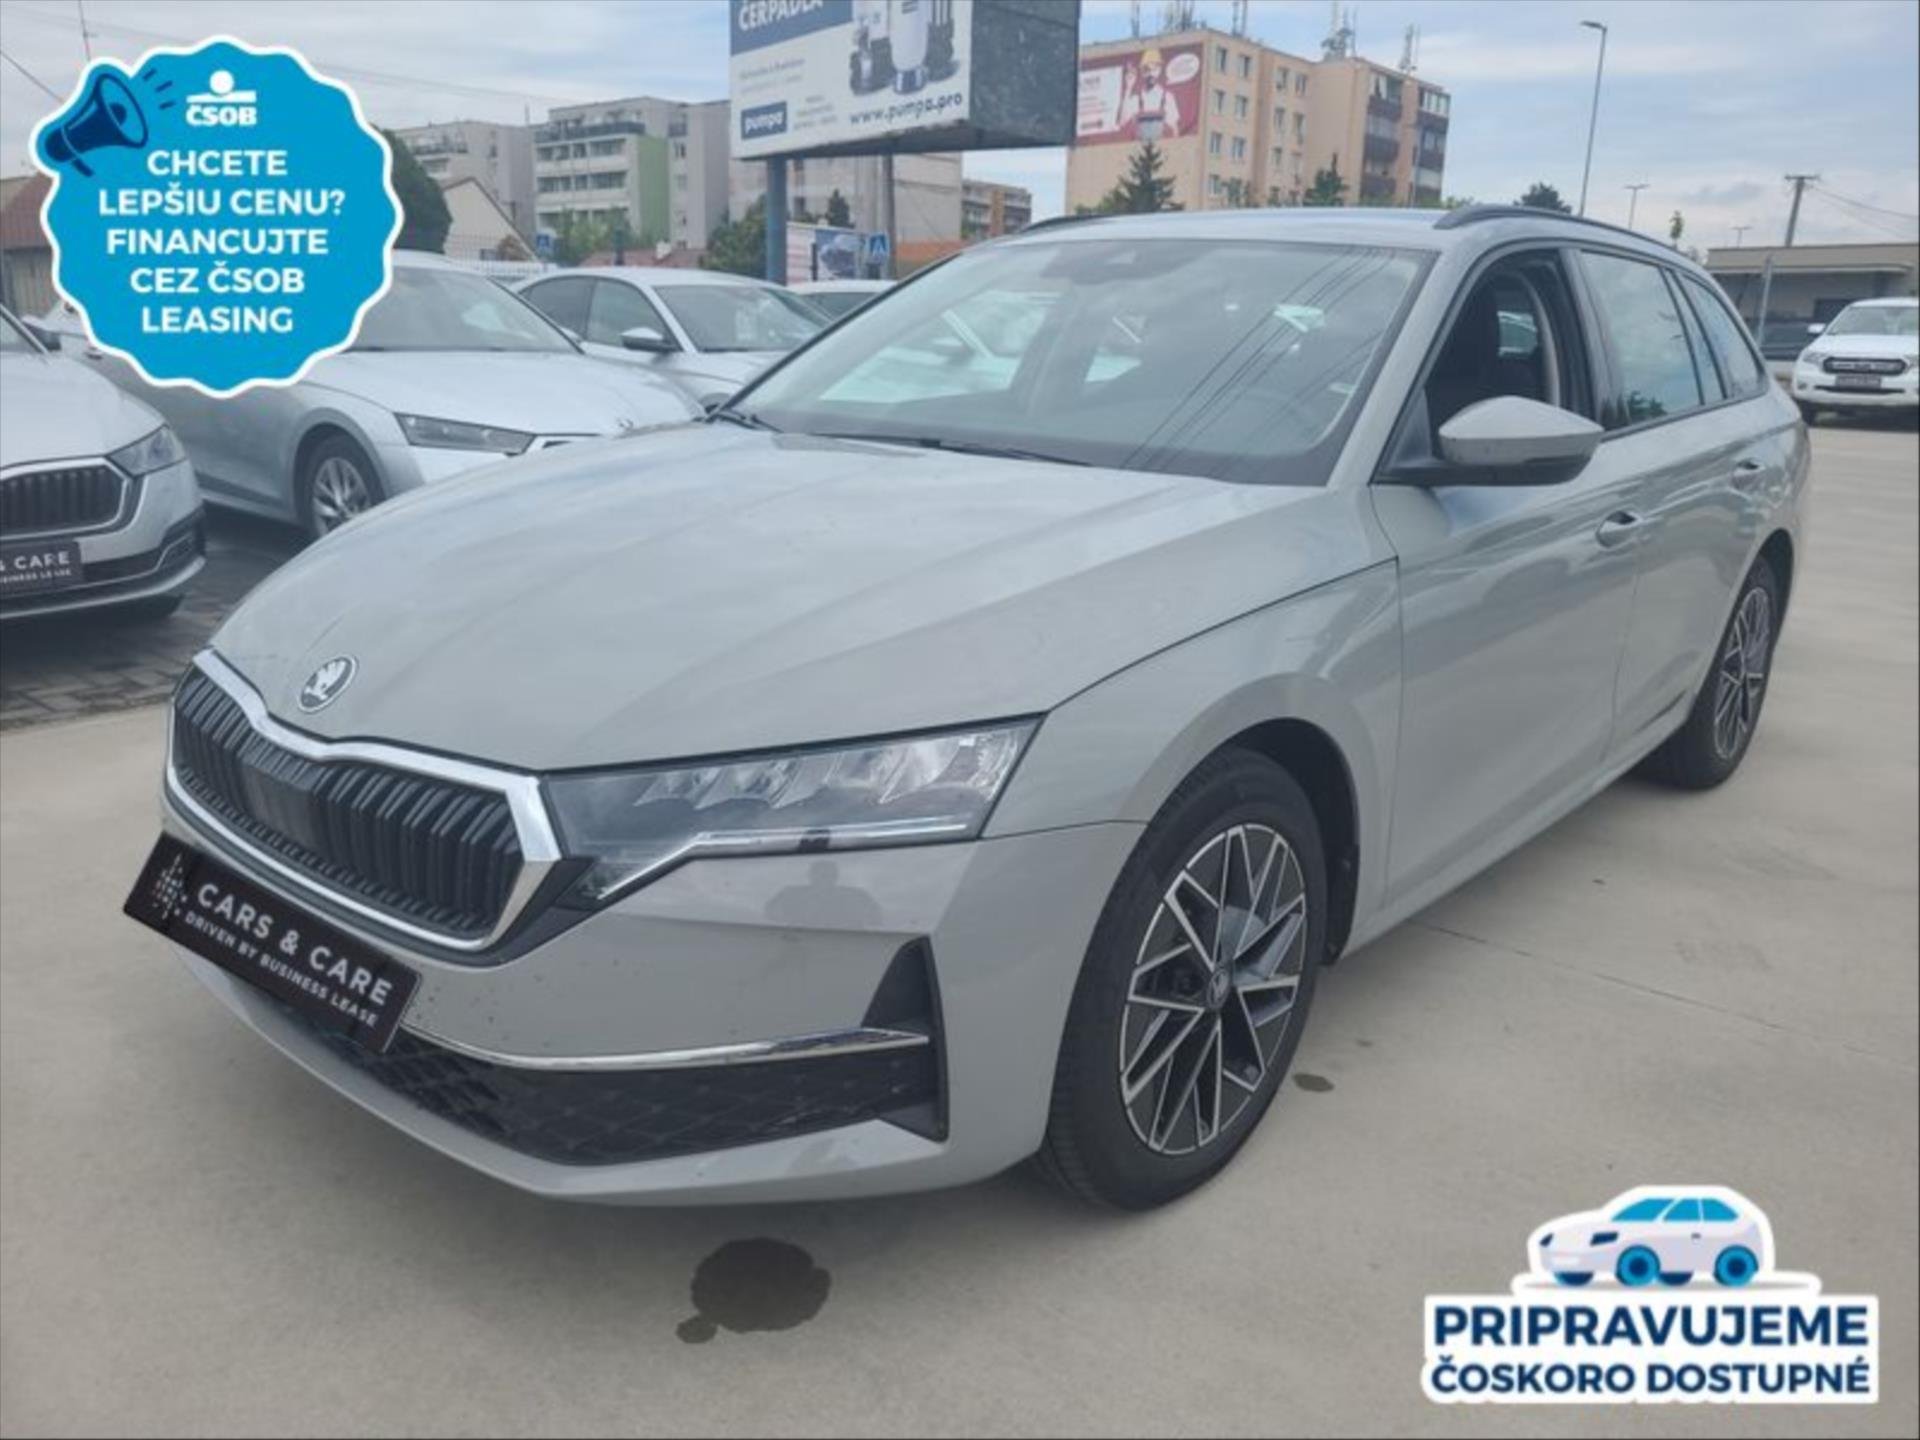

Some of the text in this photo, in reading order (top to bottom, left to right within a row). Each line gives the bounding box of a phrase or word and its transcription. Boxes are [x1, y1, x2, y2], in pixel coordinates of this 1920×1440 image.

[744, 111, 784, 134] pumpa
[849, 93, 963, 124] www.pumpa.pro
[185, 912, 379, 1028] DRIVEN BY BUSINESS LEASE
[197, 884, 394, 1006] CARS & CARE
